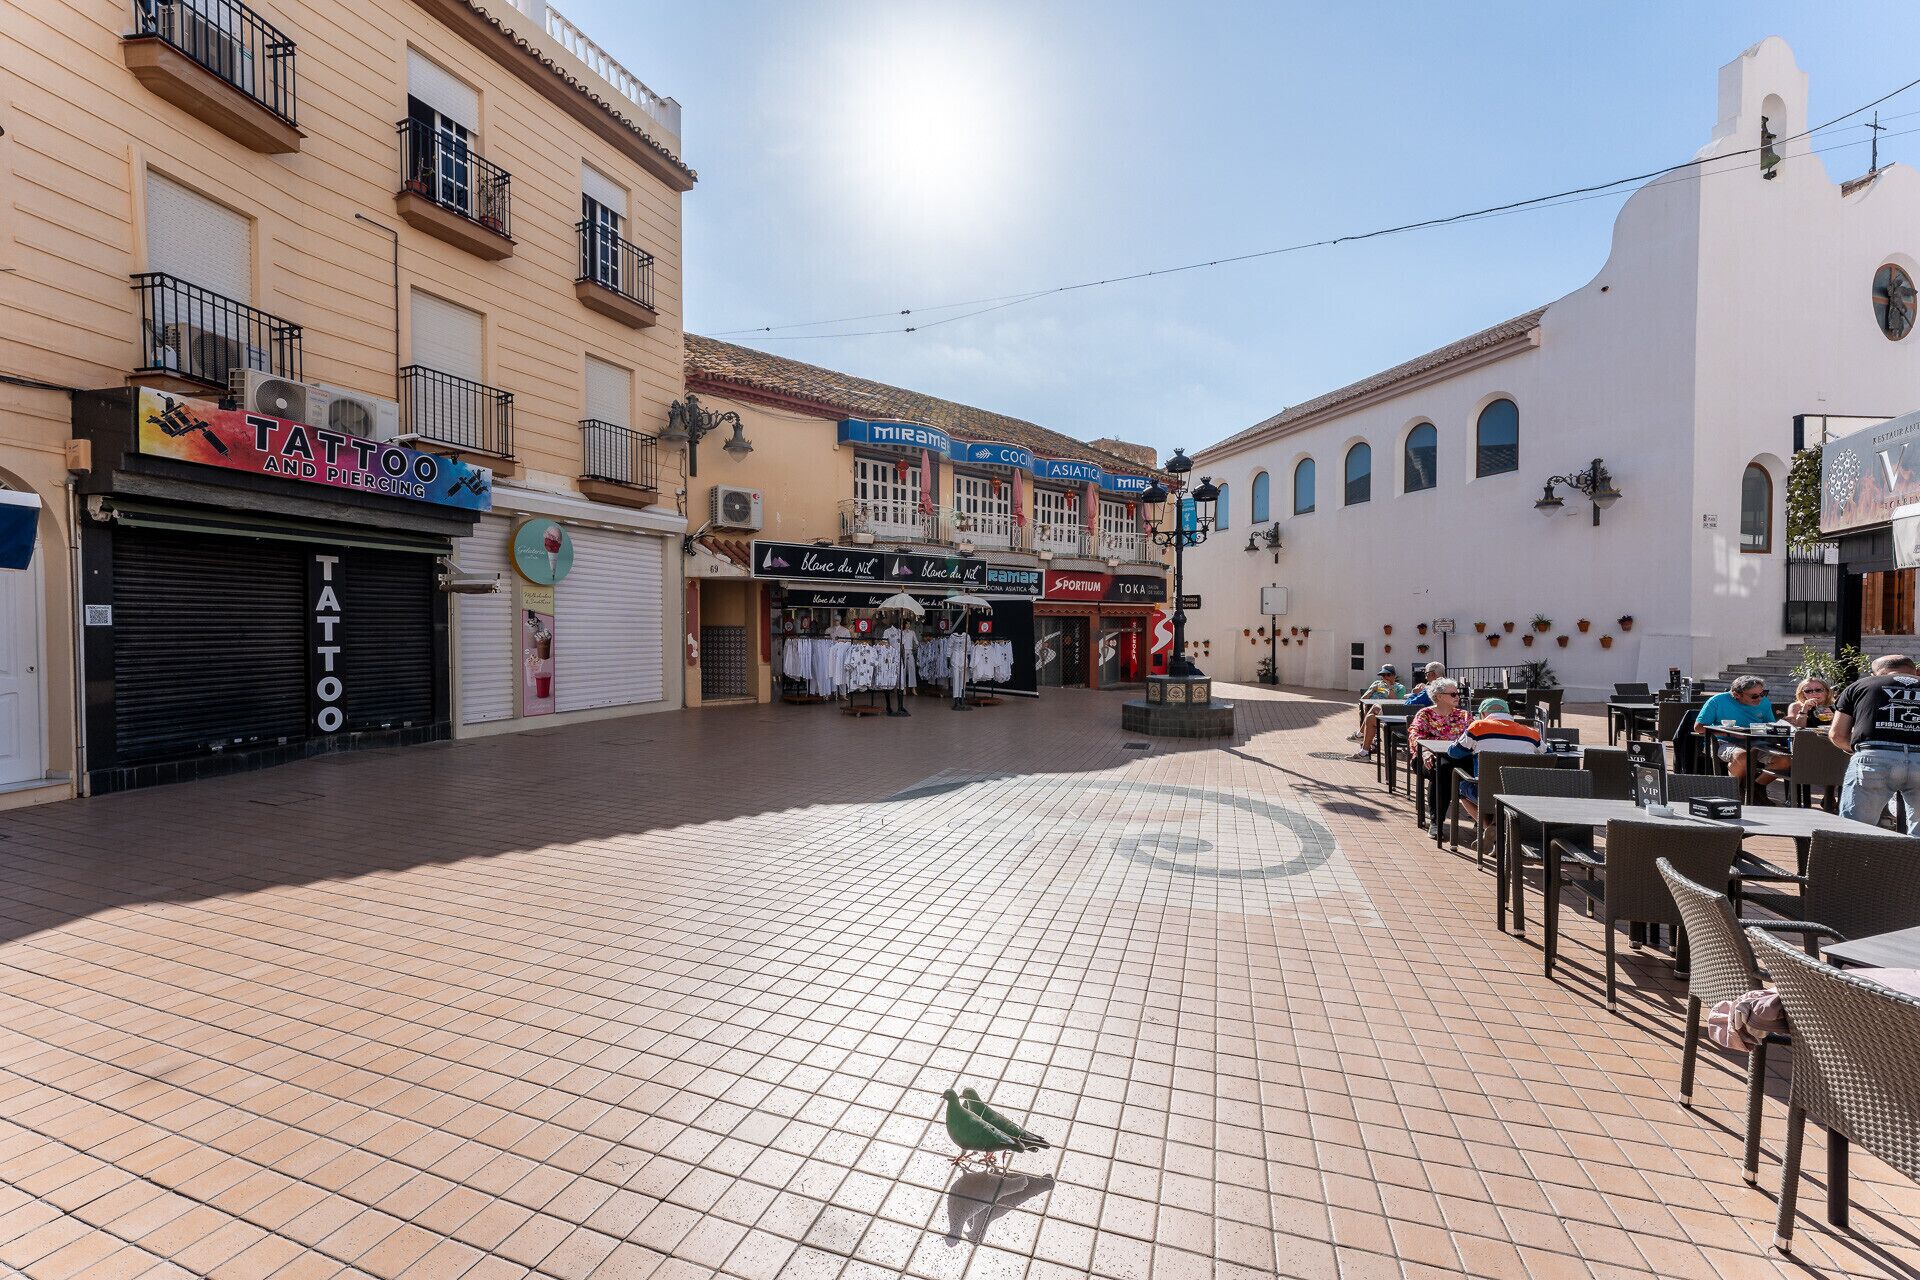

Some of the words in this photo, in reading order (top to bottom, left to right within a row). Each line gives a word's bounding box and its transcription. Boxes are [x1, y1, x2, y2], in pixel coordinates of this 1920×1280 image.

[246, 414, 438, 484] TATTOO
[263, 455, 317, 478] AND
[326, 467, 425, 499] PIERCING
[838, 558, 852, 573] du
[949, 565, 962, 579] du
[1048, 576, 1101, 592] SPORTIUM
[1119, 583, 1146, 595] TOKA
[316, 555, 343, 732] TATTOO
[1642, 786, 1659, 796] VIP
